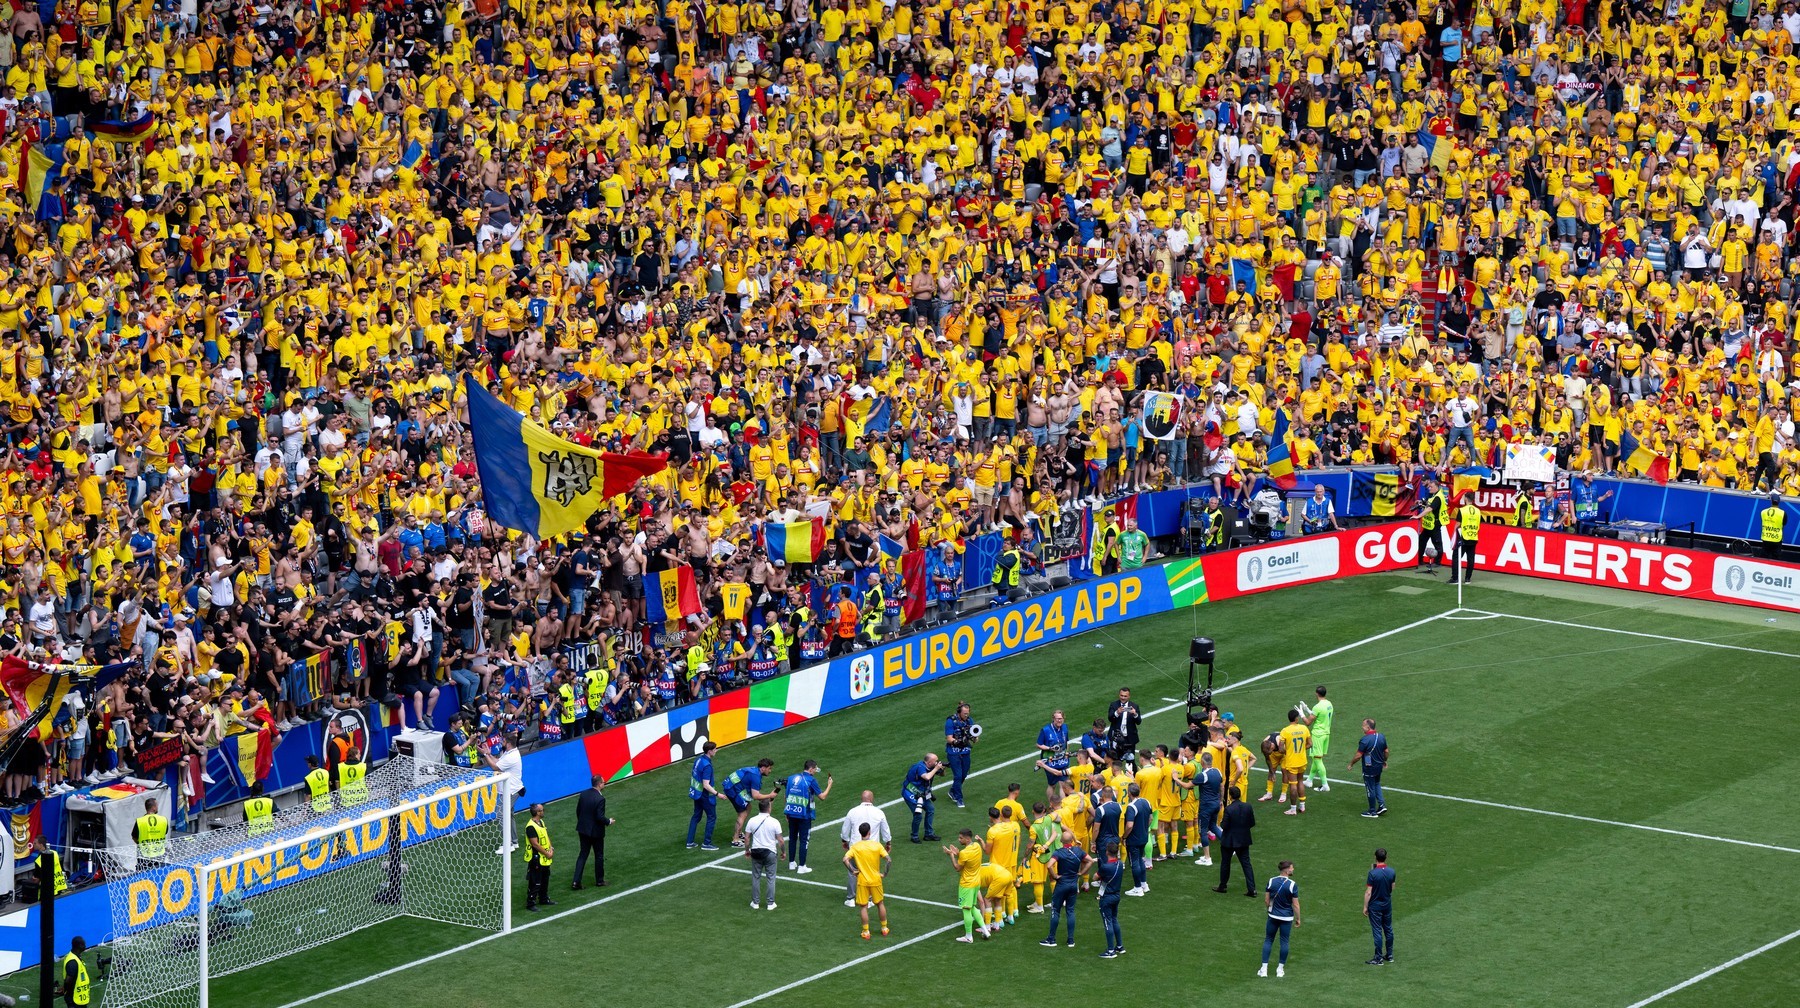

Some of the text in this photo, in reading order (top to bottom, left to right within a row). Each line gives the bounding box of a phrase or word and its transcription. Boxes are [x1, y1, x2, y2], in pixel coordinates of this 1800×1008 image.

[533, 306, 539, 318] 9
[1267, 551, 1299, 568] Goal!
[1495, 531, 1693, 591] ALERTS
[1752, 571, 1793, 589] Goal!
[729, 593, 738, 608] 11
[883, 576, 1142, 689] EURO 2024 APP
[751, 660, 775, 669] PHOTO
[1292, 737, 1304, 754] 17
[1079, 779, 1091, 795] 18
[1121, 788, 1128, 805] 2
[128, 775, 499, 928] DOWNLOAD NOW
